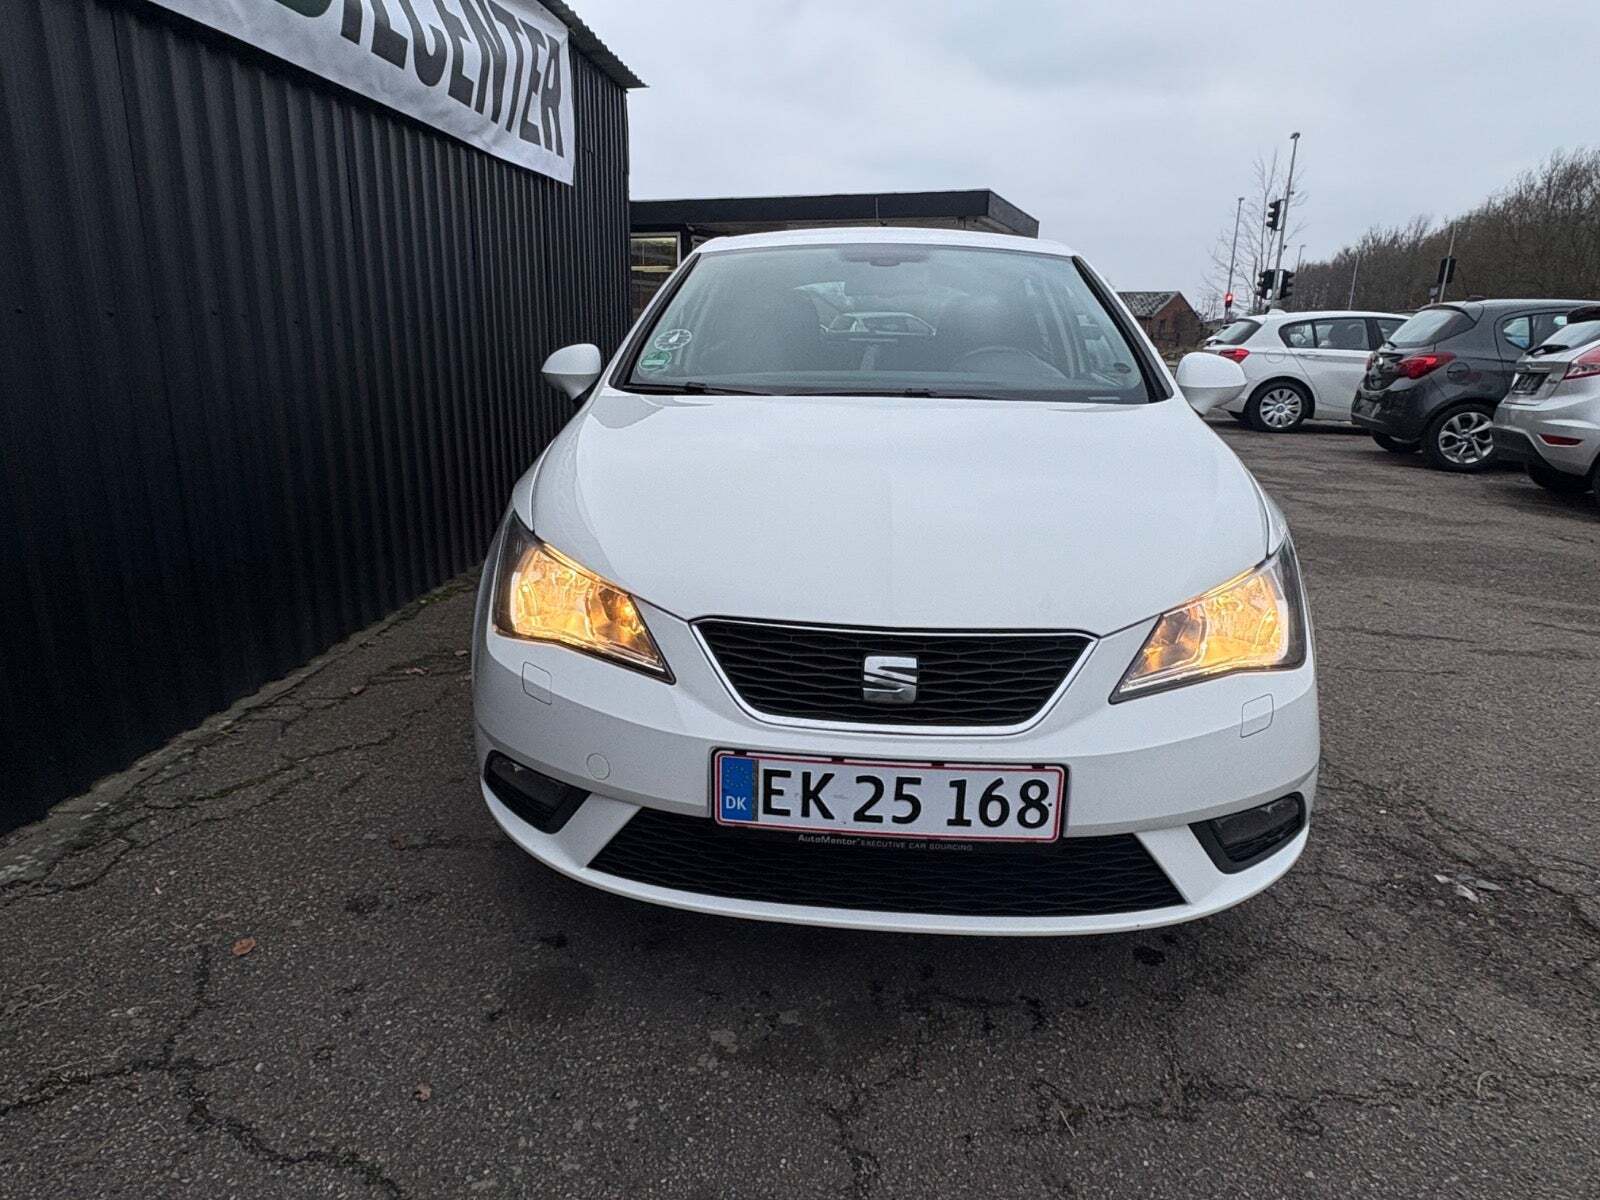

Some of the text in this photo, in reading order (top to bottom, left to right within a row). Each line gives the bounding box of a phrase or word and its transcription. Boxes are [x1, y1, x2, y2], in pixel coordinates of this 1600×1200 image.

[275, 0, 564, 158] LCENTER
[725, 795, 747, 810] DK
[762, 768, 1050, 829] EK 25 168
[860, 840, 905, 849] EXECUTIVE
[929, 843, 973, 851] SOURCING
